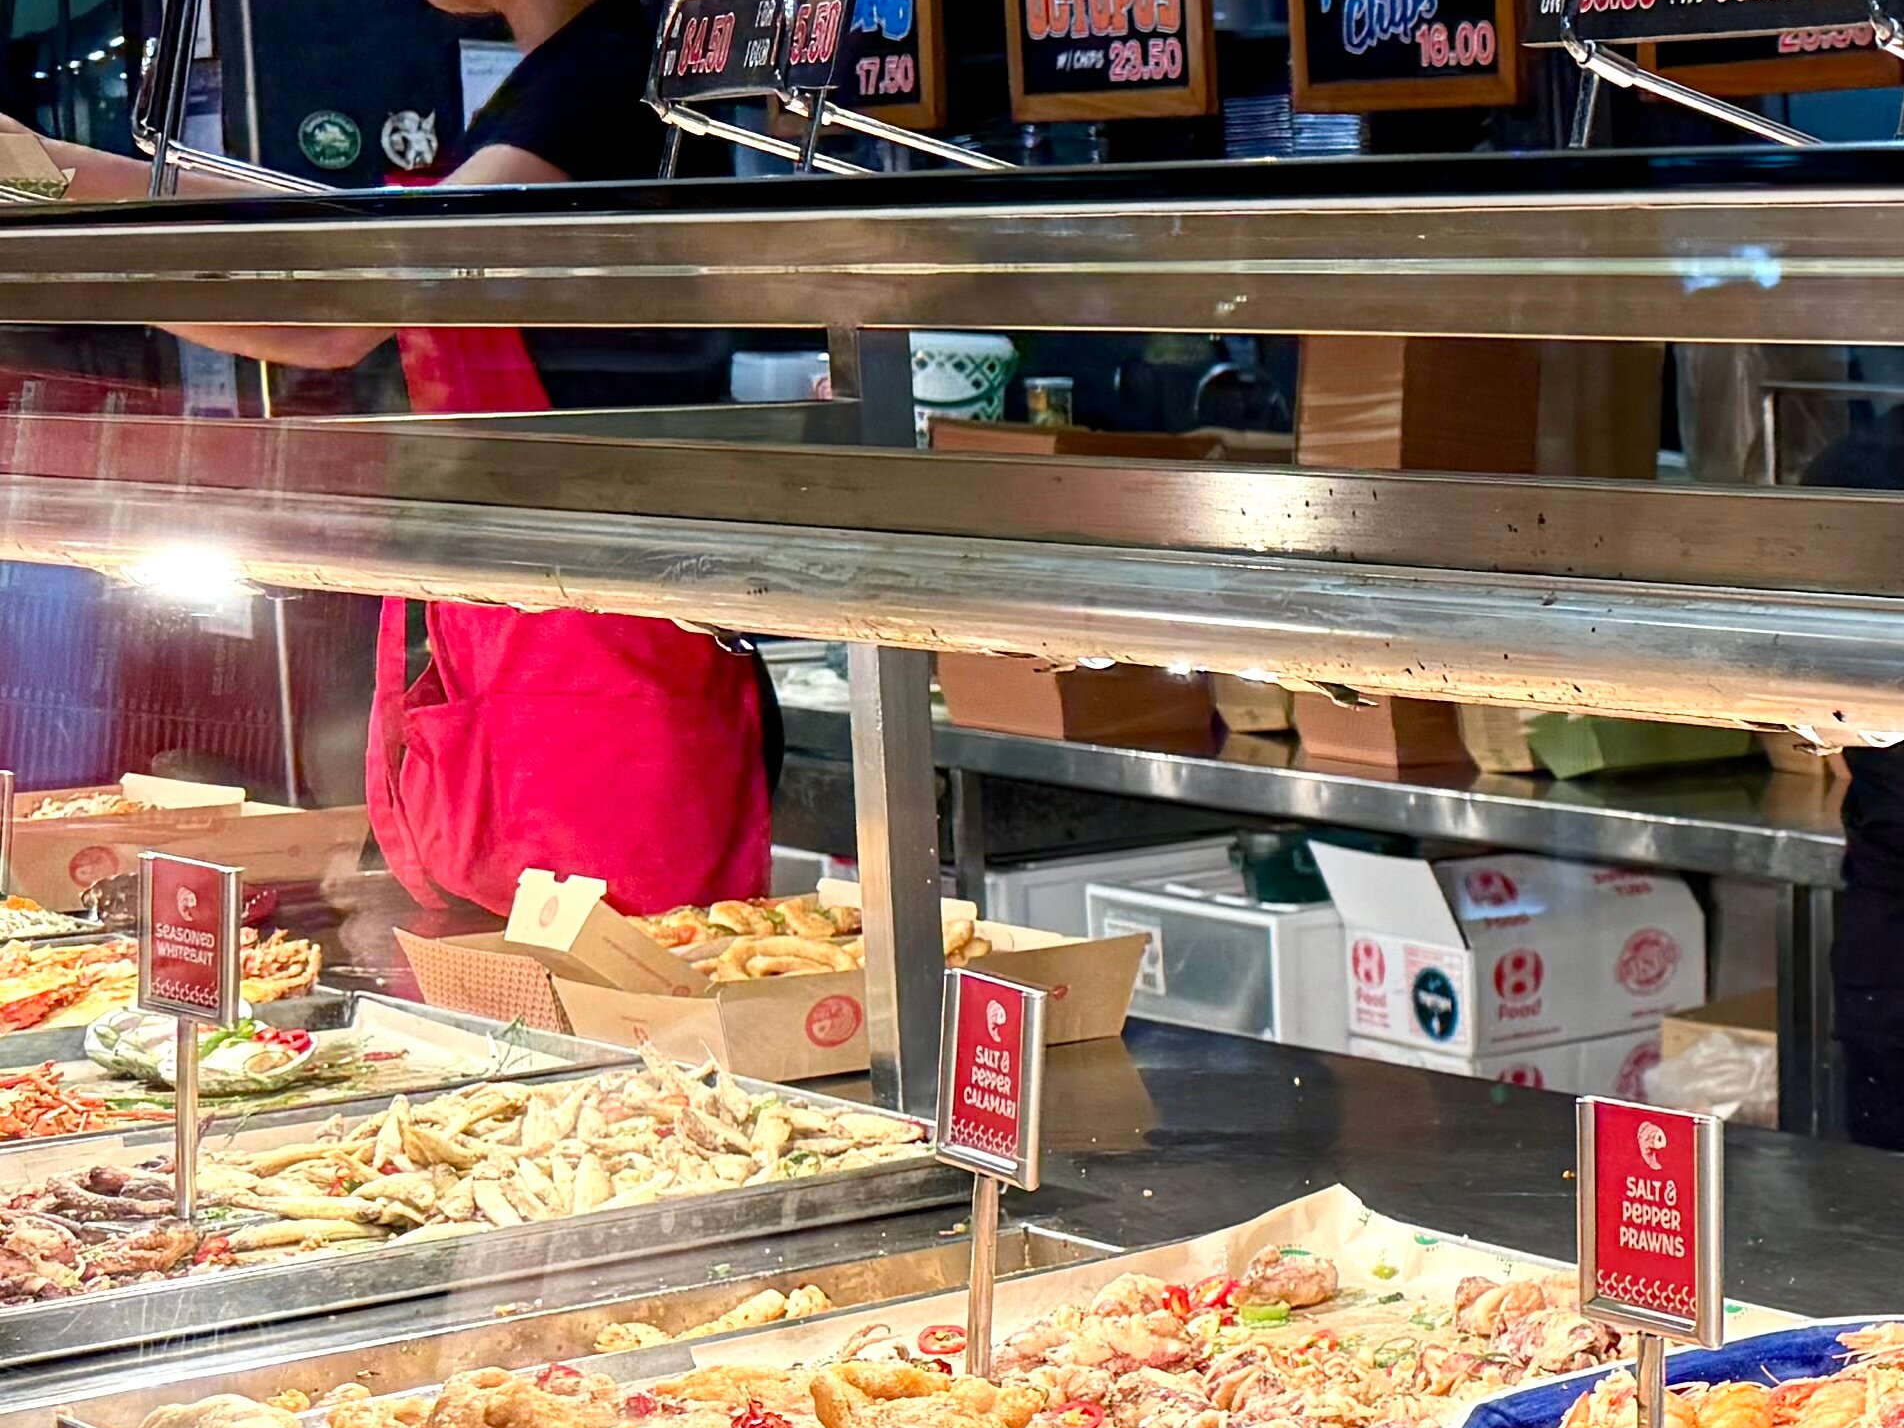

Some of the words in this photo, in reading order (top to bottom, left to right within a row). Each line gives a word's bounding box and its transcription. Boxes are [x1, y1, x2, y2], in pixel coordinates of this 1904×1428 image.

[1107, 37, 1182, 82] 23.50
[1416, 20, 1496, 67] 16.00
[854, 55, 915, 96] 17.50
[975, 1045, 1000, 1070] SALT
[963, 1085, 1016, 1120] CALAMARI
[1624, 1175, 1660, 1206] SALT
[1663, 1178, 1677, 1206] &
[1618, 1225, 1687, 1260] PRAWNS
